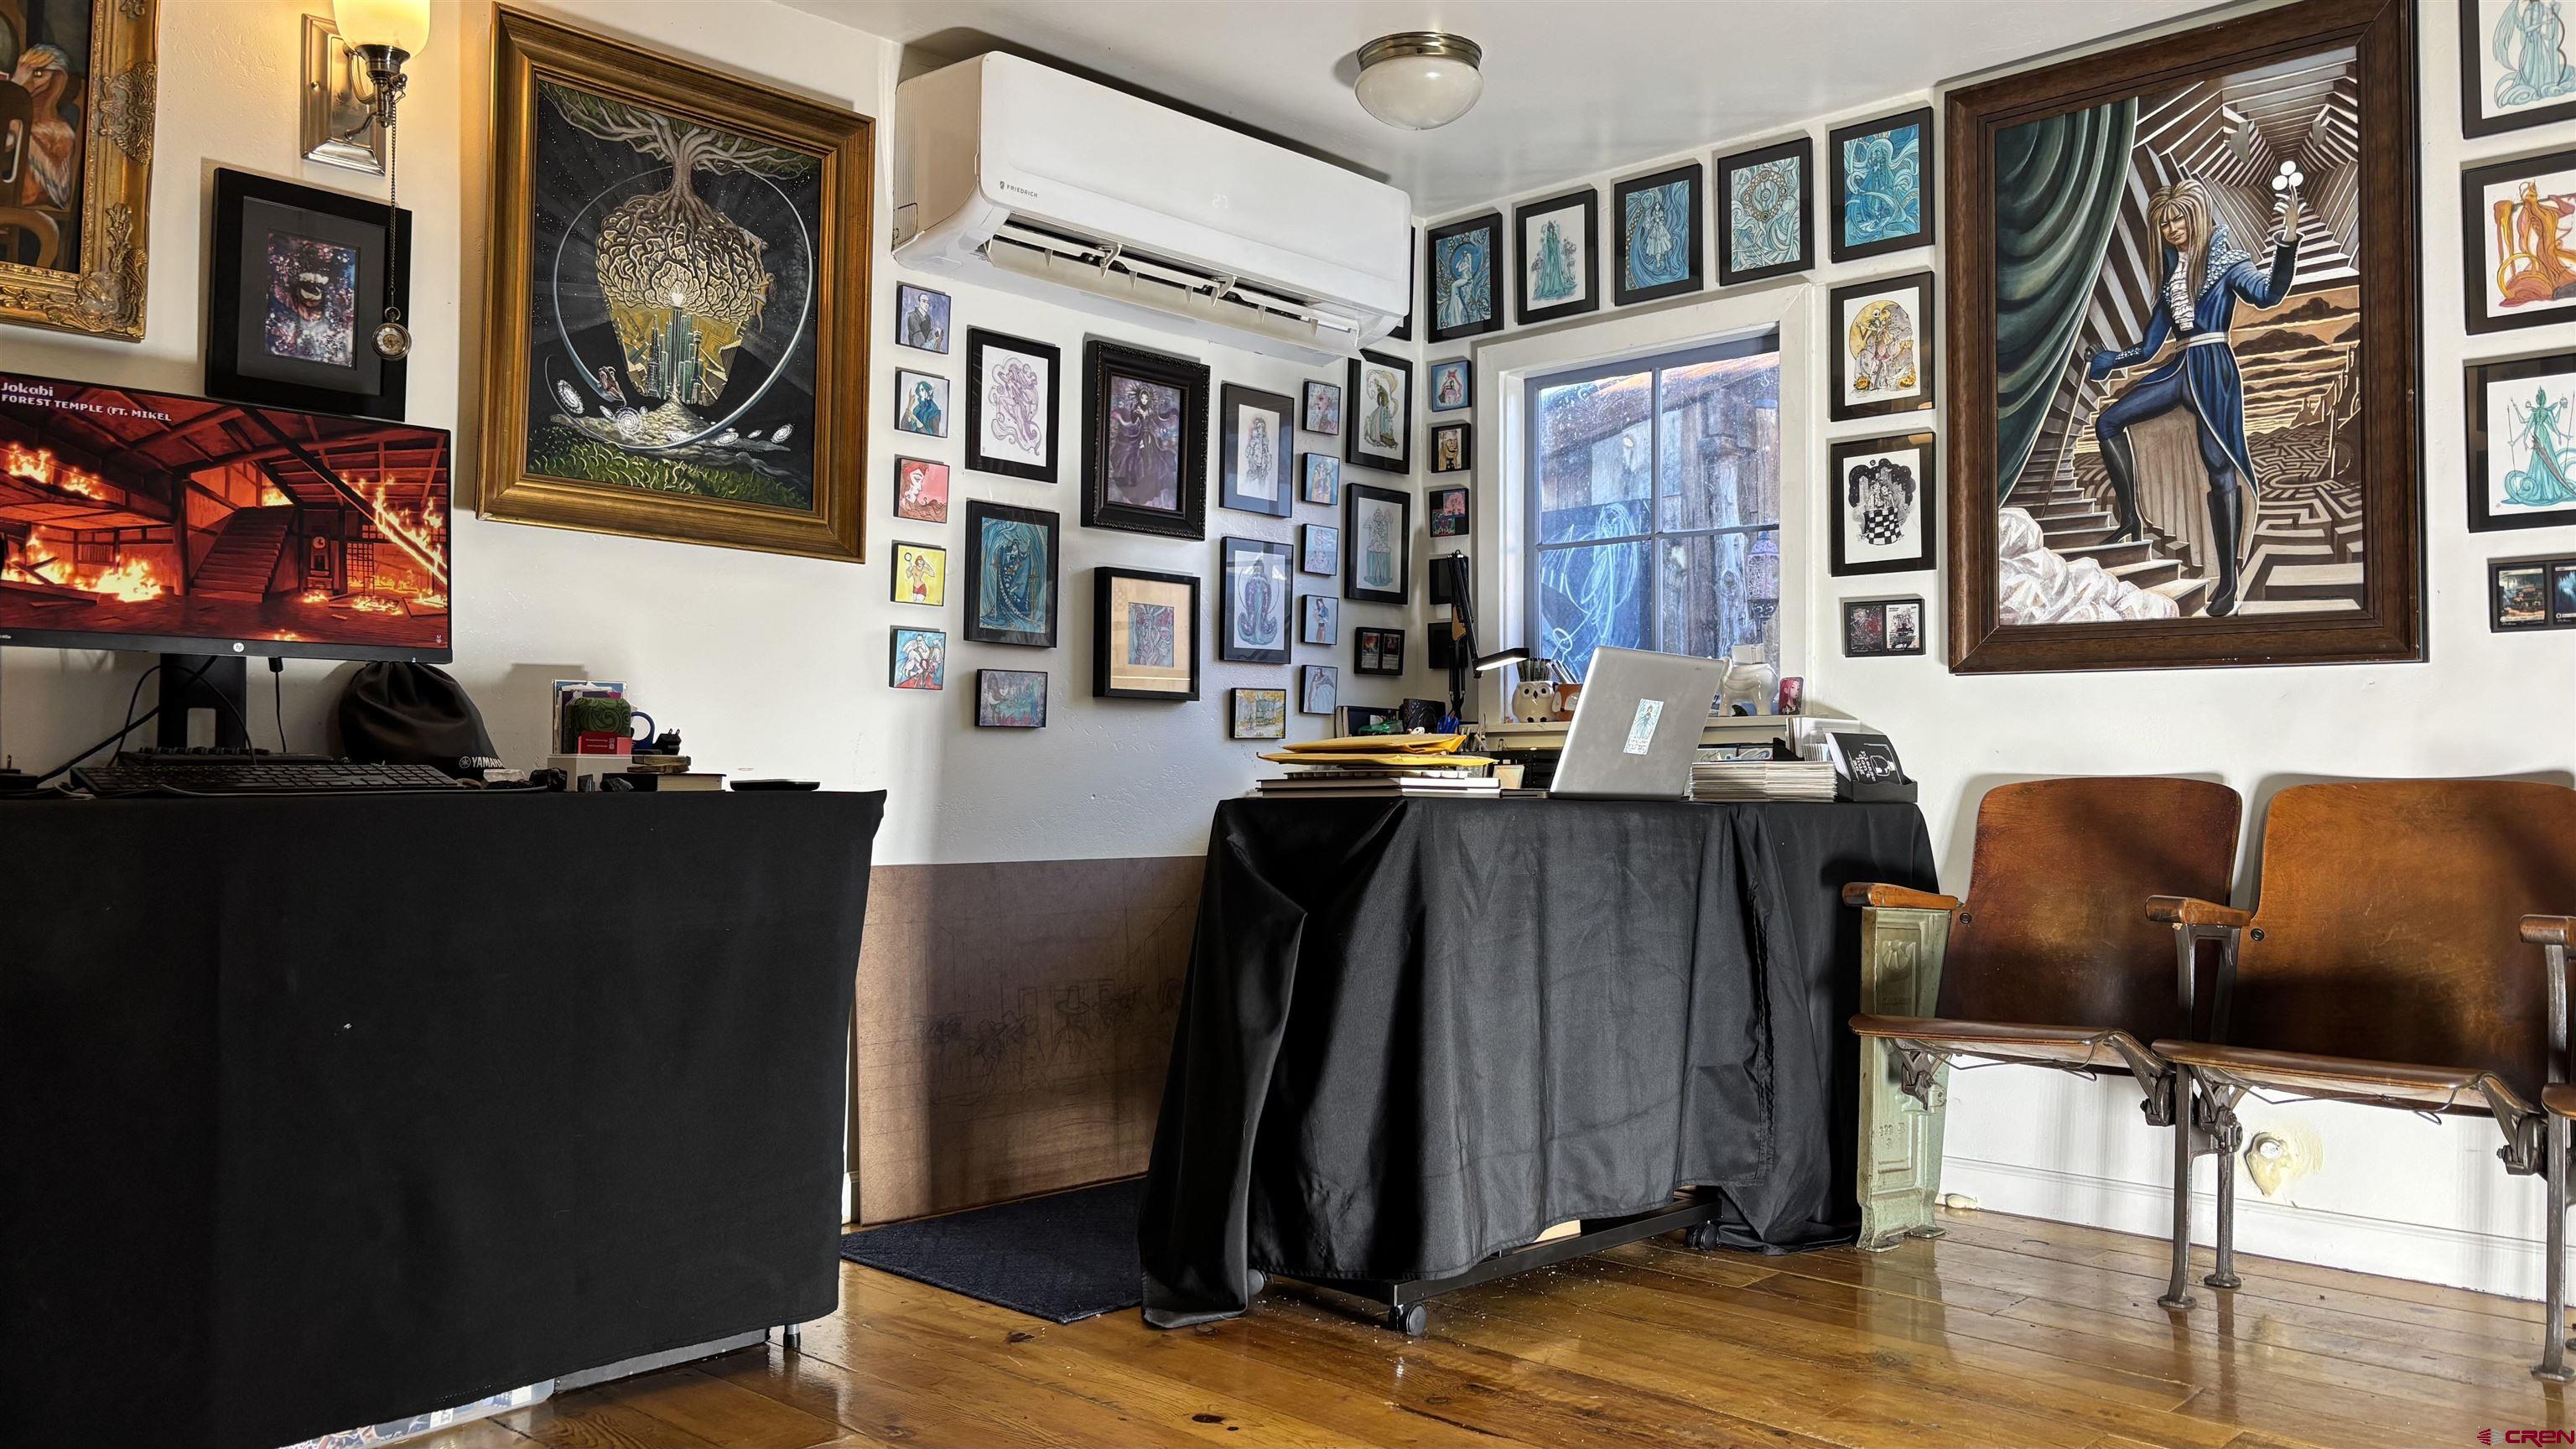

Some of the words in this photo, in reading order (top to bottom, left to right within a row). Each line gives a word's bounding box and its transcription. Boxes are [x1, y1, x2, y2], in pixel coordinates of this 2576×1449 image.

[1006, 184, 1038, 198] FRIEDRICH
[1, 382, 54, 397] Jokabi
[2, 394, 51, 407] FOREST
[55, 400, 103, 413] TEMPLE
[106, 407, 128, 416] (FT.
[132, 408, 172, 422] MIKEL
[471, 756, 504, 768] YAMAHA
[1858, 754, 1871, 778] don't
[1861, 750, 1876, 782] please
